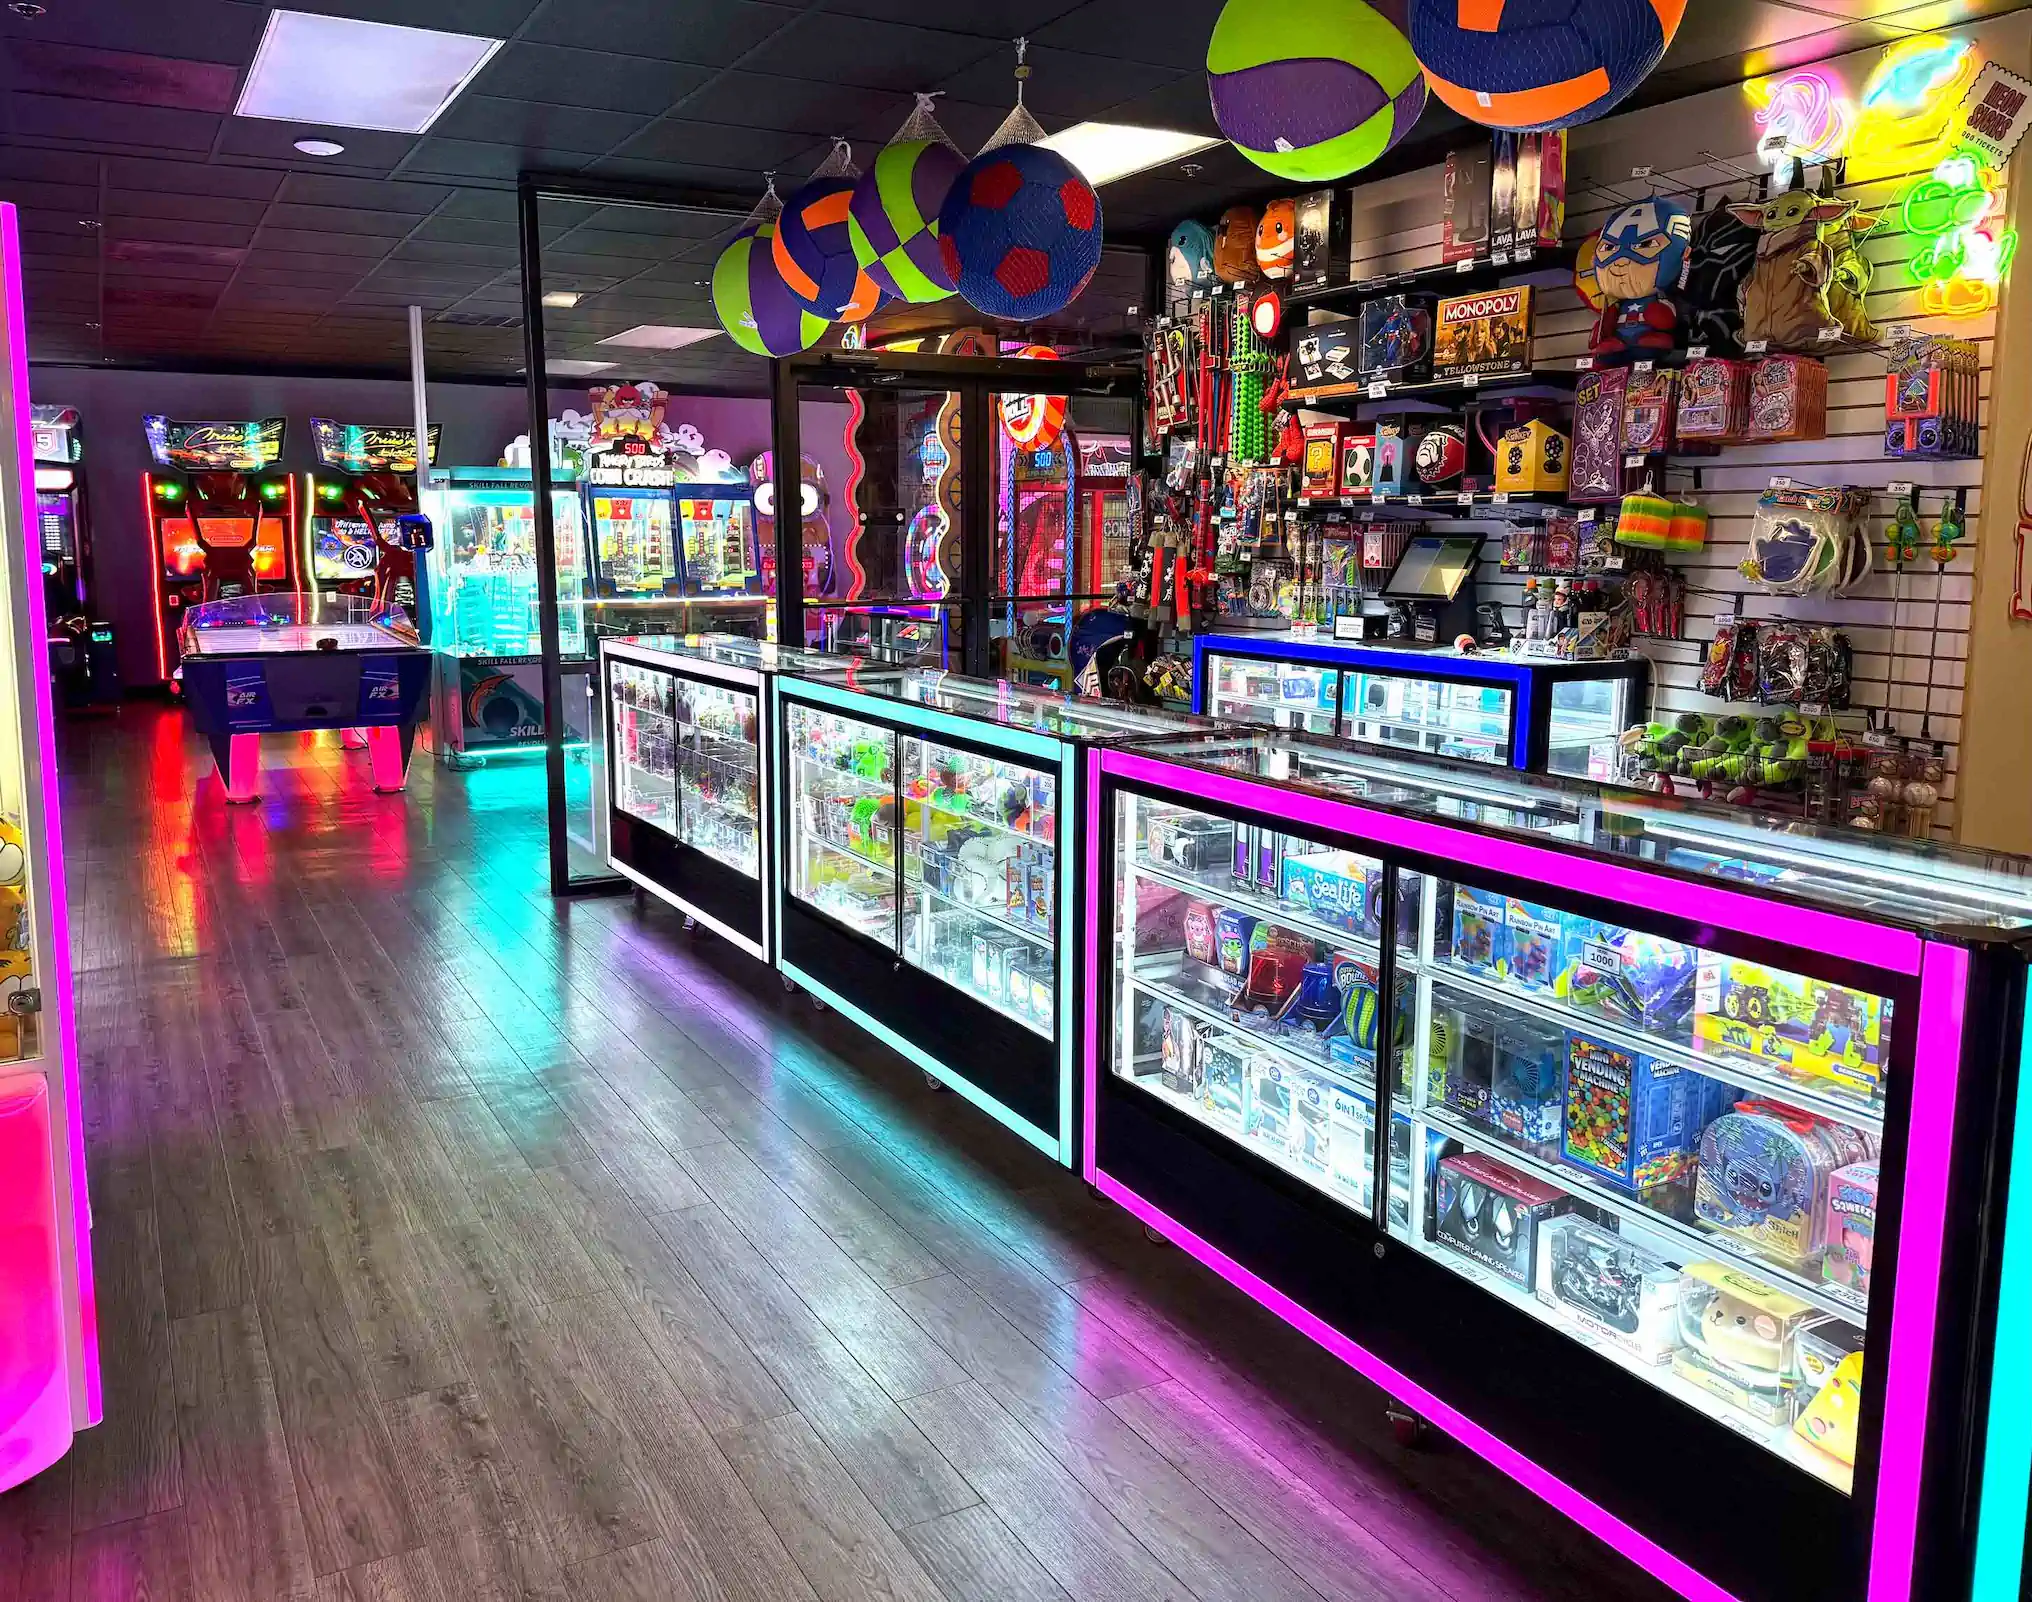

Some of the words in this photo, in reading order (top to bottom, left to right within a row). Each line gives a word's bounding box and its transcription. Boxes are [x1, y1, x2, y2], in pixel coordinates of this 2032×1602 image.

[1975, 138, 2004, 156] TICKETS
[1491, 234, 1513, 247] LAVA
[1516, 228, 1537, 240] LAVA
[1677, 261, 1691, 290] MARVEL
[1445, 295, 1518, 322] MONOPOLY
[1443, 360, 1511, 376] YELLOWSTONE
[1577, 383, 1601, 406] SET
[624, 443, 646, 454] 500
[1034, 451, 1052, 467] 500
[510, 725, 545, 737] SKILL
[1312, 872, 1337, 899] Sea
[1337, 879, 1361, 912] Life
[1590, 952, 1614, 967] 1000
[1589, 1049, 1609, 1064] MINI
[1574, 1056, 1626, 1087] VENDING
[1579, 1070, 1619, 1093] MACHINE
[1437, 1231, 1471, 1252] COMPUTER
[1470, 1248, 1496, 1266] GAMING
[1495, 1260, 1526, 1281] SPEAKER
